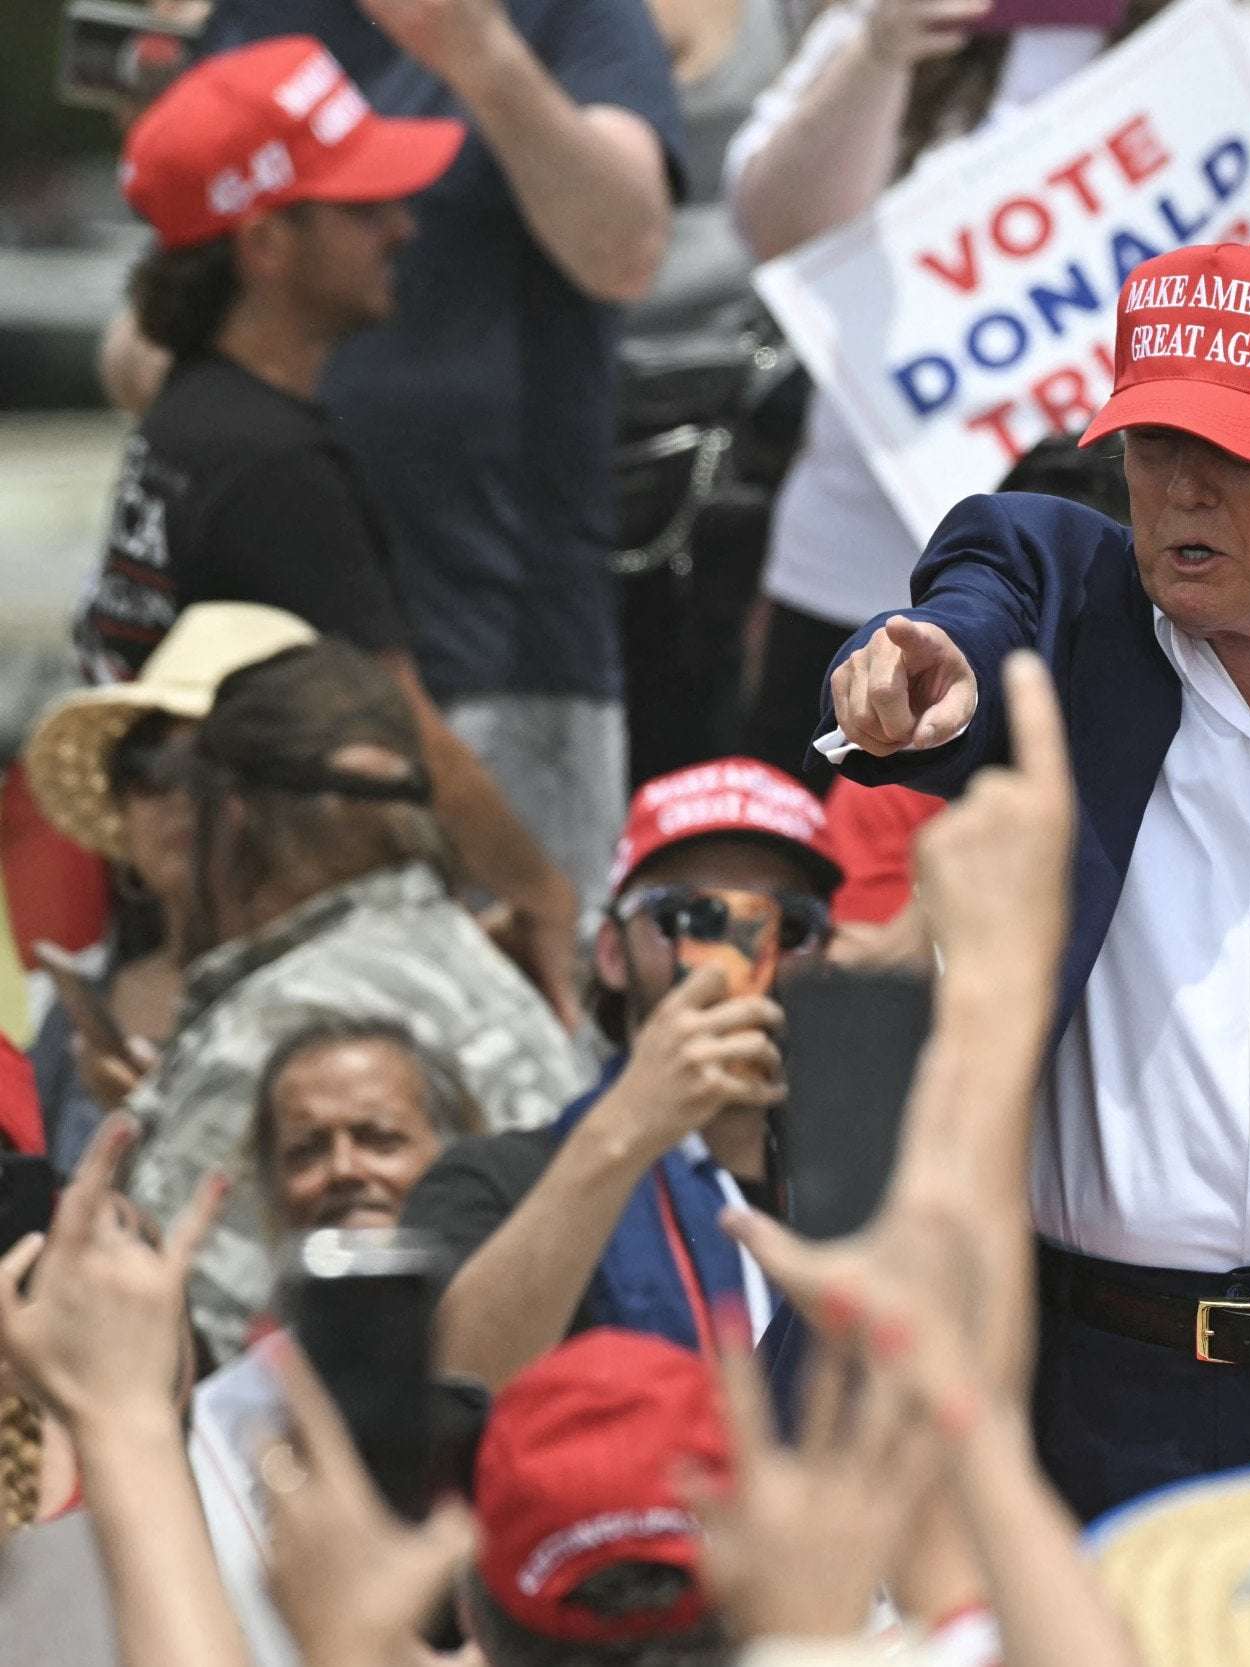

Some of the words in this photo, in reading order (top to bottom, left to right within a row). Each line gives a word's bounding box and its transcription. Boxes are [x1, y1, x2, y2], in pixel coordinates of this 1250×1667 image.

[917, 112, 1172, 296] VOTE
[1125, 274, 1188, 314] MAKE
[1131, 323, 1204, 362] GREAT
